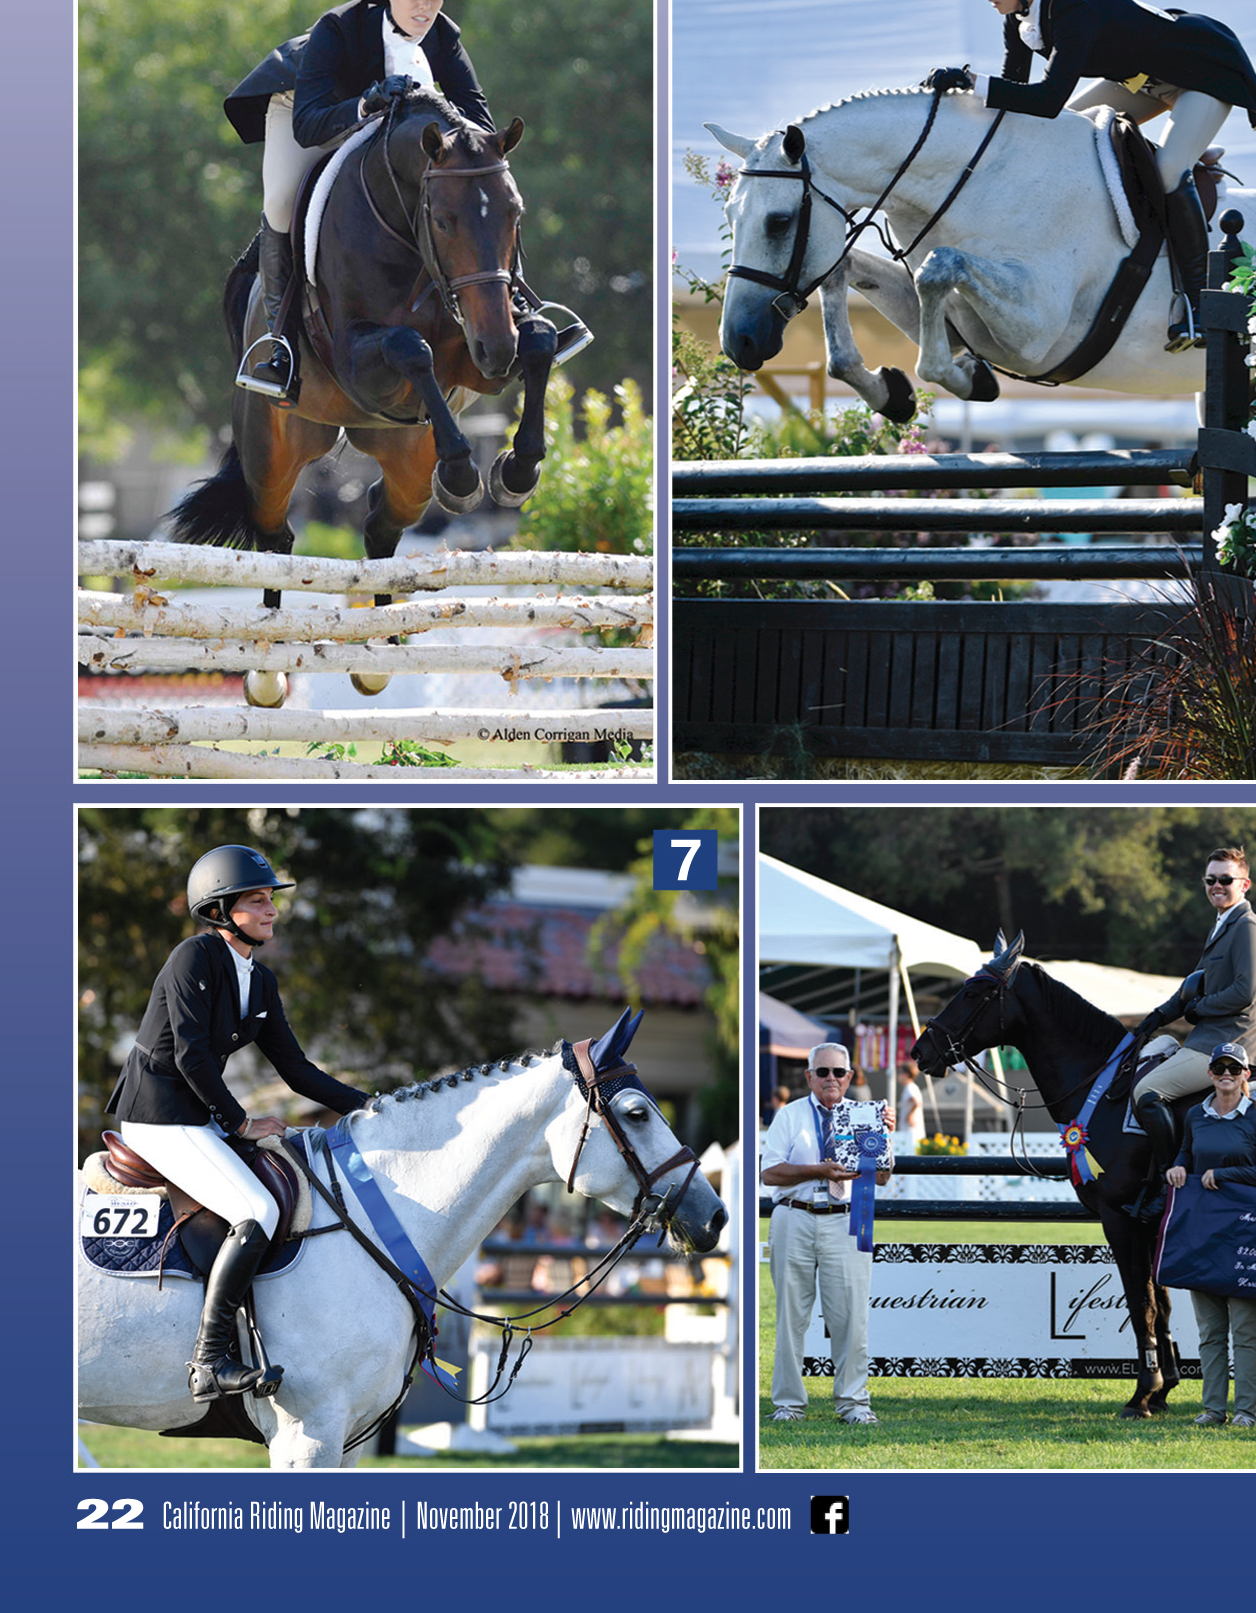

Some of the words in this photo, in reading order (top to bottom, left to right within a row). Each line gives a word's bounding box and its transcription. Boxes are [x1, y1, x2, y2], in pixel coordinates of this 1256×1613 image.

[93, 1208, 149, 1235] 672
[868, 1288, 989, 1309] uestrian
[76, 1498, 144, 1530] 22
[163, 1500, 243, 1530] California
[250, 1501, 303, 1534] Riding
[310, 1501, 391, 1534] Magazine
[417, 1501, 503, 1530] November
[508, 1500, 549, 1530] 2018
[570, 1501, 791, 1534] www.ridingmagazine.com
